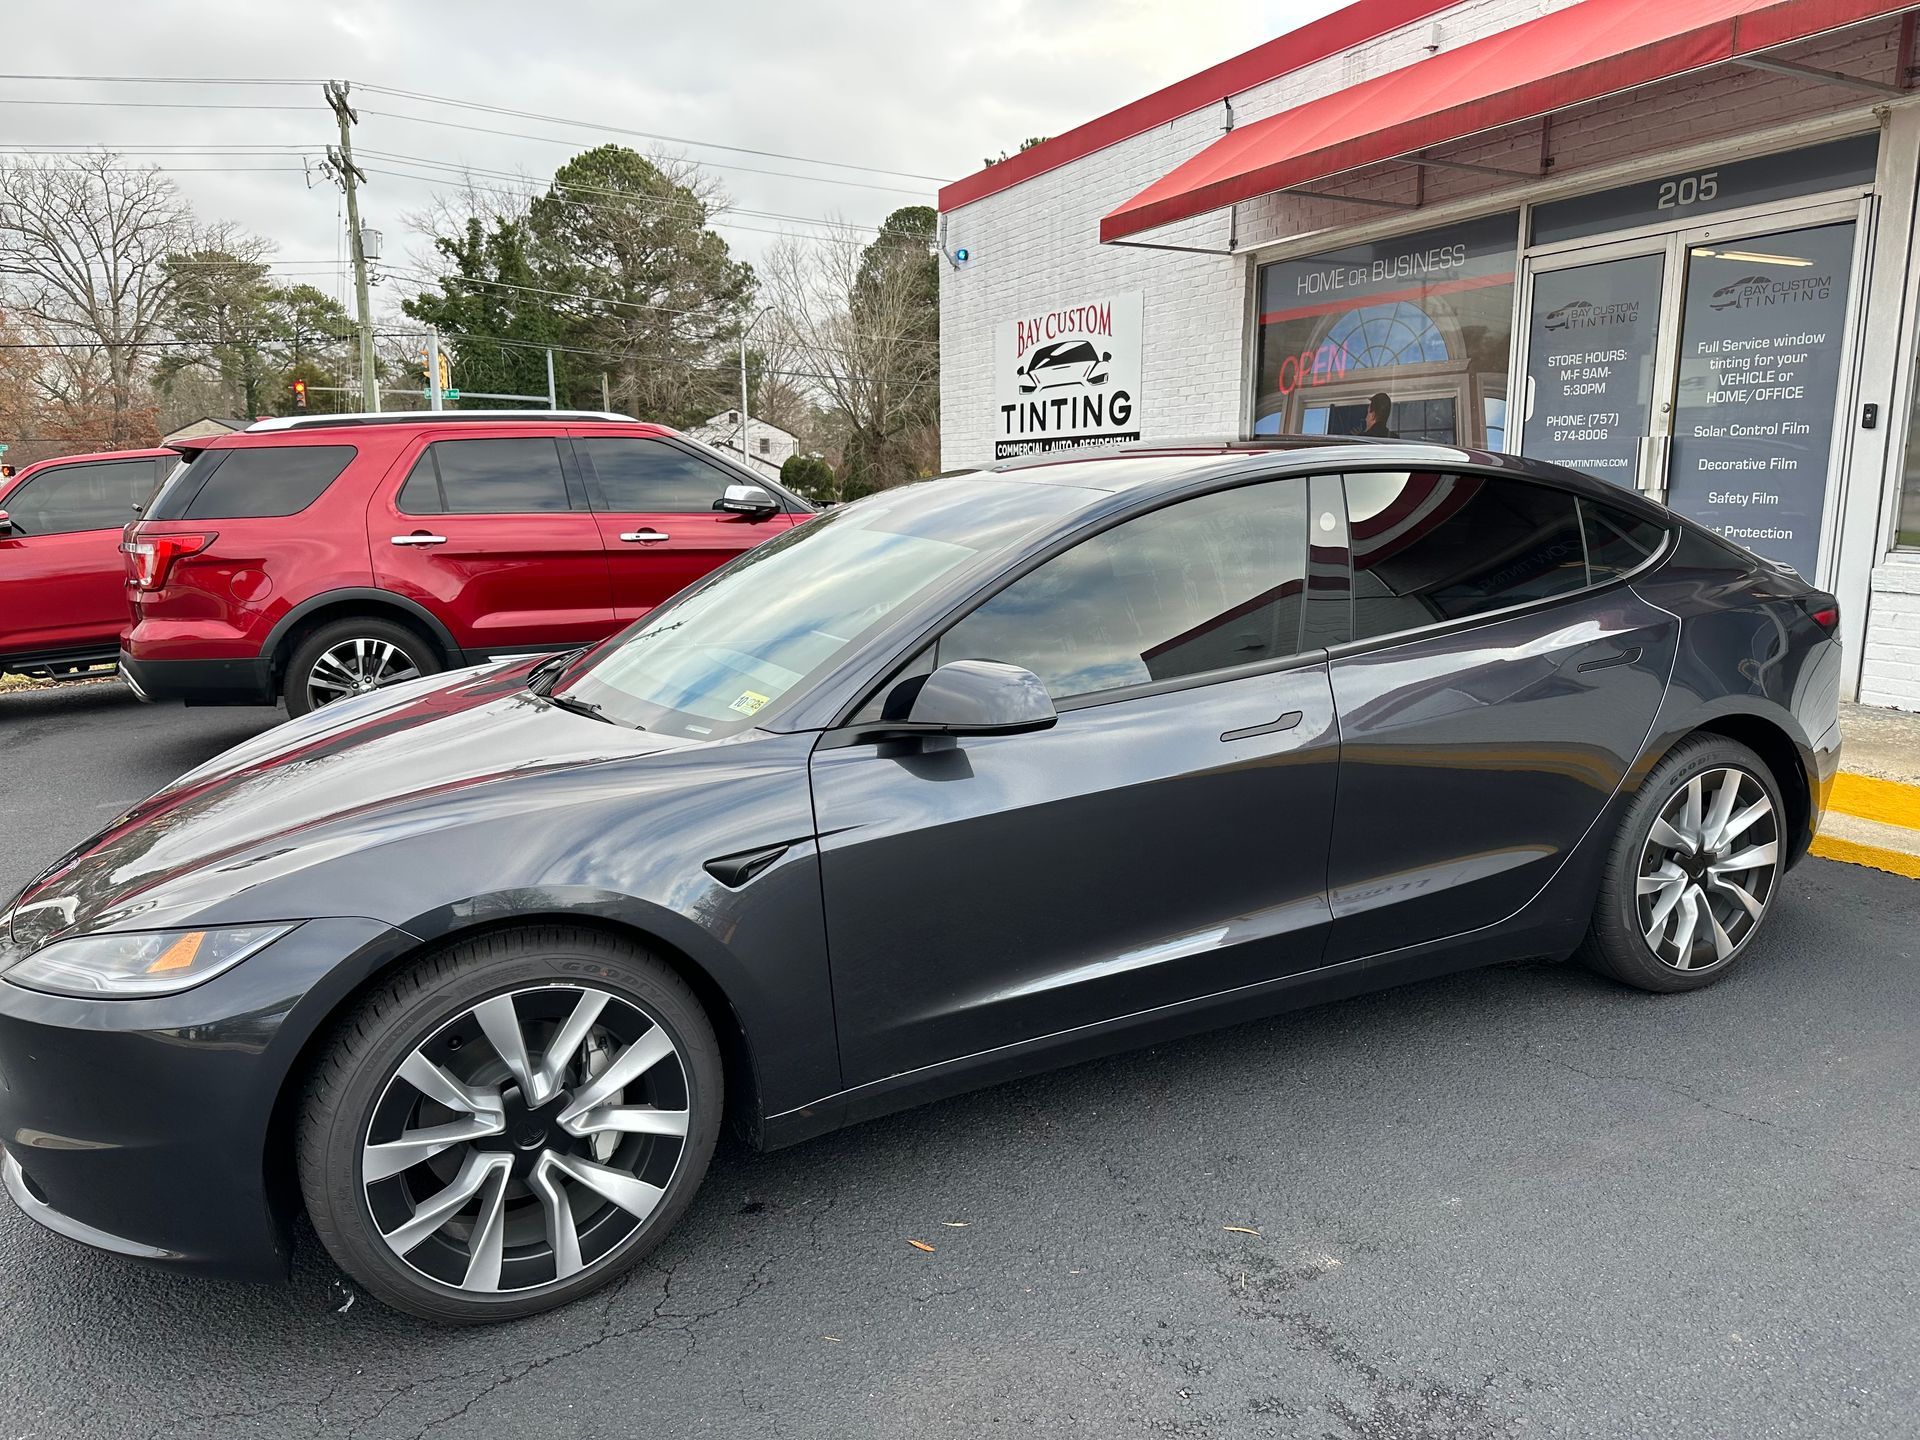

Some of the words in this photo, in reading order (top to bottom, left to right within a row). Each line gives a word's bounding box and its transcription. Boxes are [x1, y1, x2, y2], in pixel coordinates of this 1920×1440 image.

[1658, 172, 1718, 210] 205
[1297, 268, 1344, 296] HOME
[1348, 268, 1367, 286] OR
[1372, 243, 1466, 282] BUSINESS
[1744, 284, 1769, 297] BAY
[1772, 276, 1832, 293] CUSTOM
[1743, 287, 1830, 308] TINTING
[1571, 308, 1591, 319] BAY
[1593, 301, 1640, 316] CUSTOM
[1571, 311, 1638, 329] TINTING
[1017, 316, 1043, 358] BAY
[1046, 301, 1113, 339] CUSTOM
[1698, 340, 1719, 354] Full
[1722, 337, 1770, 352] Service
[1774, 332, 1826, 347] window
[1548, 353, 1583, 367] STORE
[1584, 350, 1628, 364] HOURS:
[1709, 356, 1751, 370] tinting
[1754, 354, 1774, 367] for
[1777, 352, 1808, 368] your
[1279, 343, 1348, 396] OPEN
[1560, 368, 1580, 381] M-F
[1582, 367, 1612, 380] 9AM-
[1719, 370, 1775, 386] VEHICLE
[1778, 371, 1794, 382] or
[1563, 383, 1606, 396] 5:30PM
[1706, 386, 1804, 405] HOME/OFFICE
[1001, 390, 1132, 434] TINTING
[1546, 415, 1586, 427] PHONE:
[1588, 413, 1619, 427] (757)
[1554, 429, 1608, 441] 874-8006
[1694, 425, 1727, 438] Solar
[1730, 423, 1778, 436] Control
[1782, 422, 1810, 435] Film
[997, 442, 1043, 456] COMMERCIAL
[1698, 458, 1766, 471] Decorative
[1770, 458, 1798, 470] Film
[1708, 491, 1749, 507] Safety
[1751, 492, 1779, 505] Film
[1724, 525, 1793, 540] Protection
